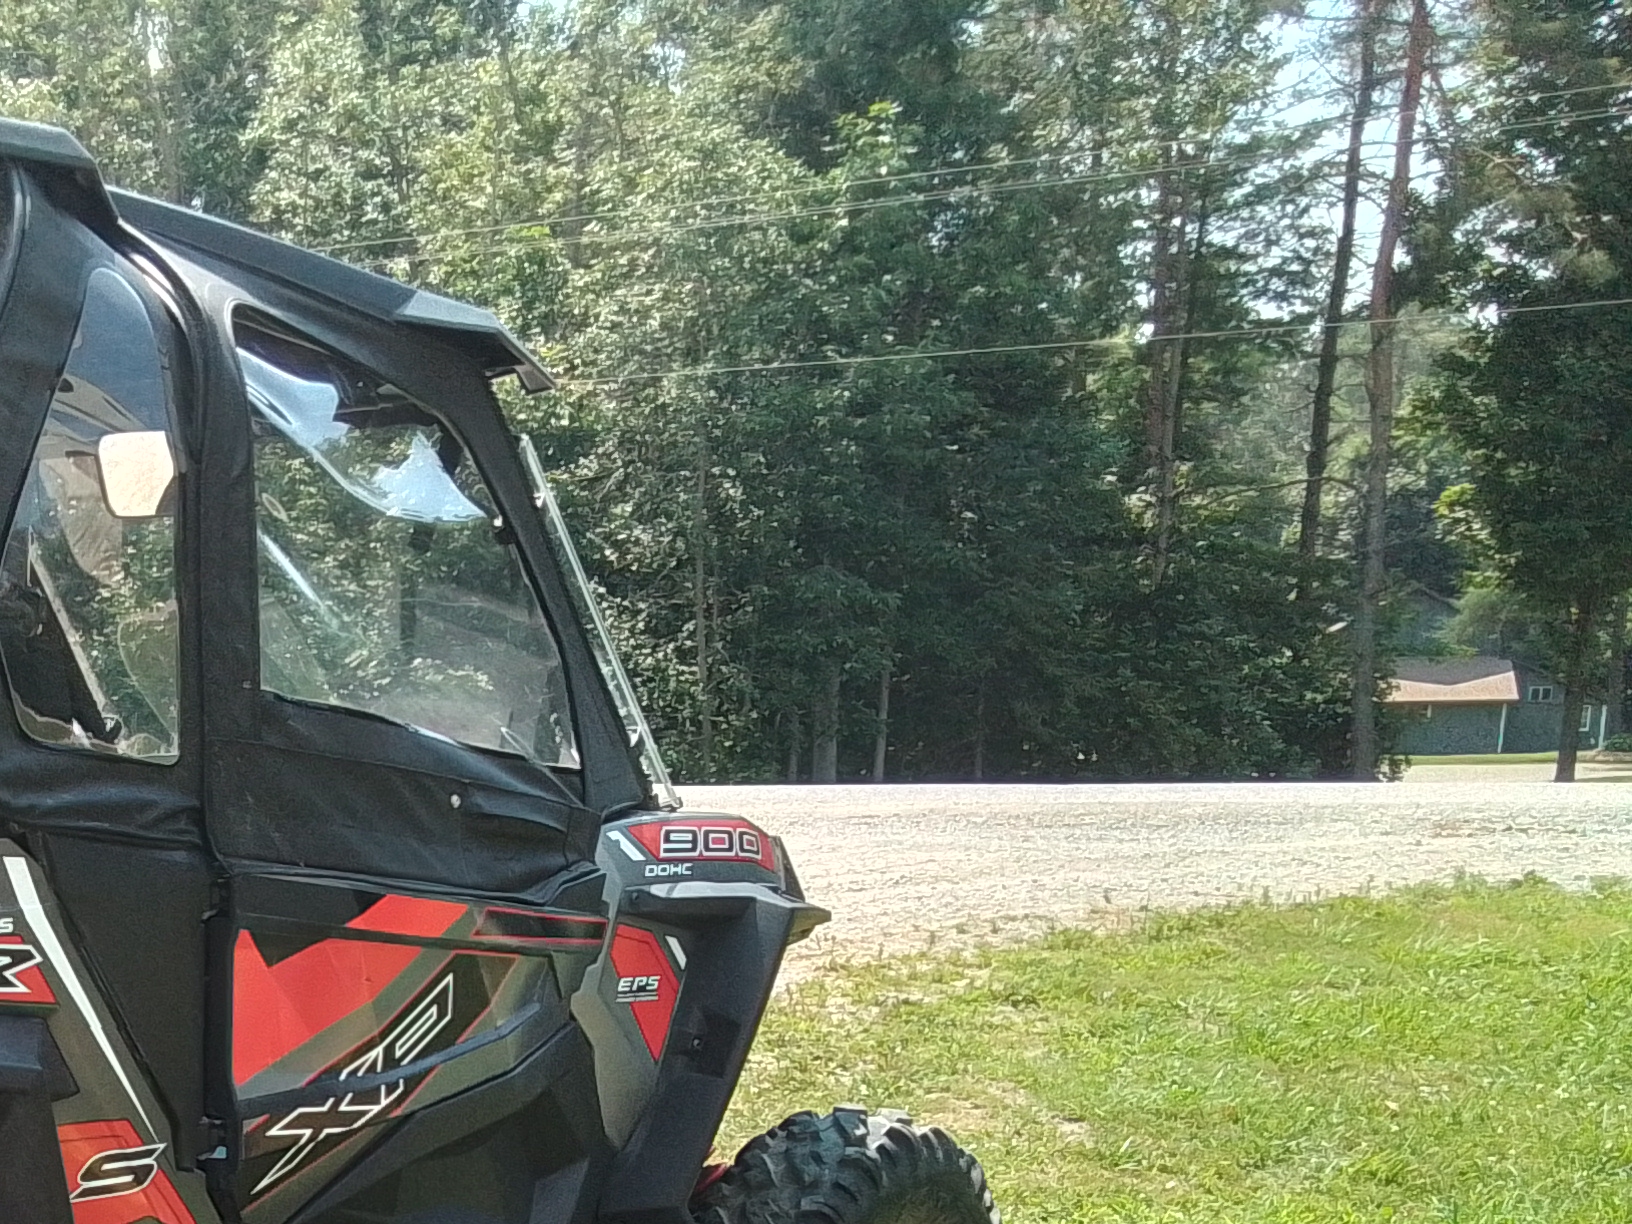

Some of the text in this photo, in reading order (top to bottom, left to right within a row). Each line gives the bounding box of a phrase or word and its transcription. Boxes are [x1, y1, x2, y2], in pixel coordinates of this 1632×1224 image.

[659, 826, 761, 860] 900
[644, 862, 694, 877] DOHC
[617, 975, 661, 992] EPS
[251, 972, 454, 1195] XP
[69, 1142, 167, 1203] S
